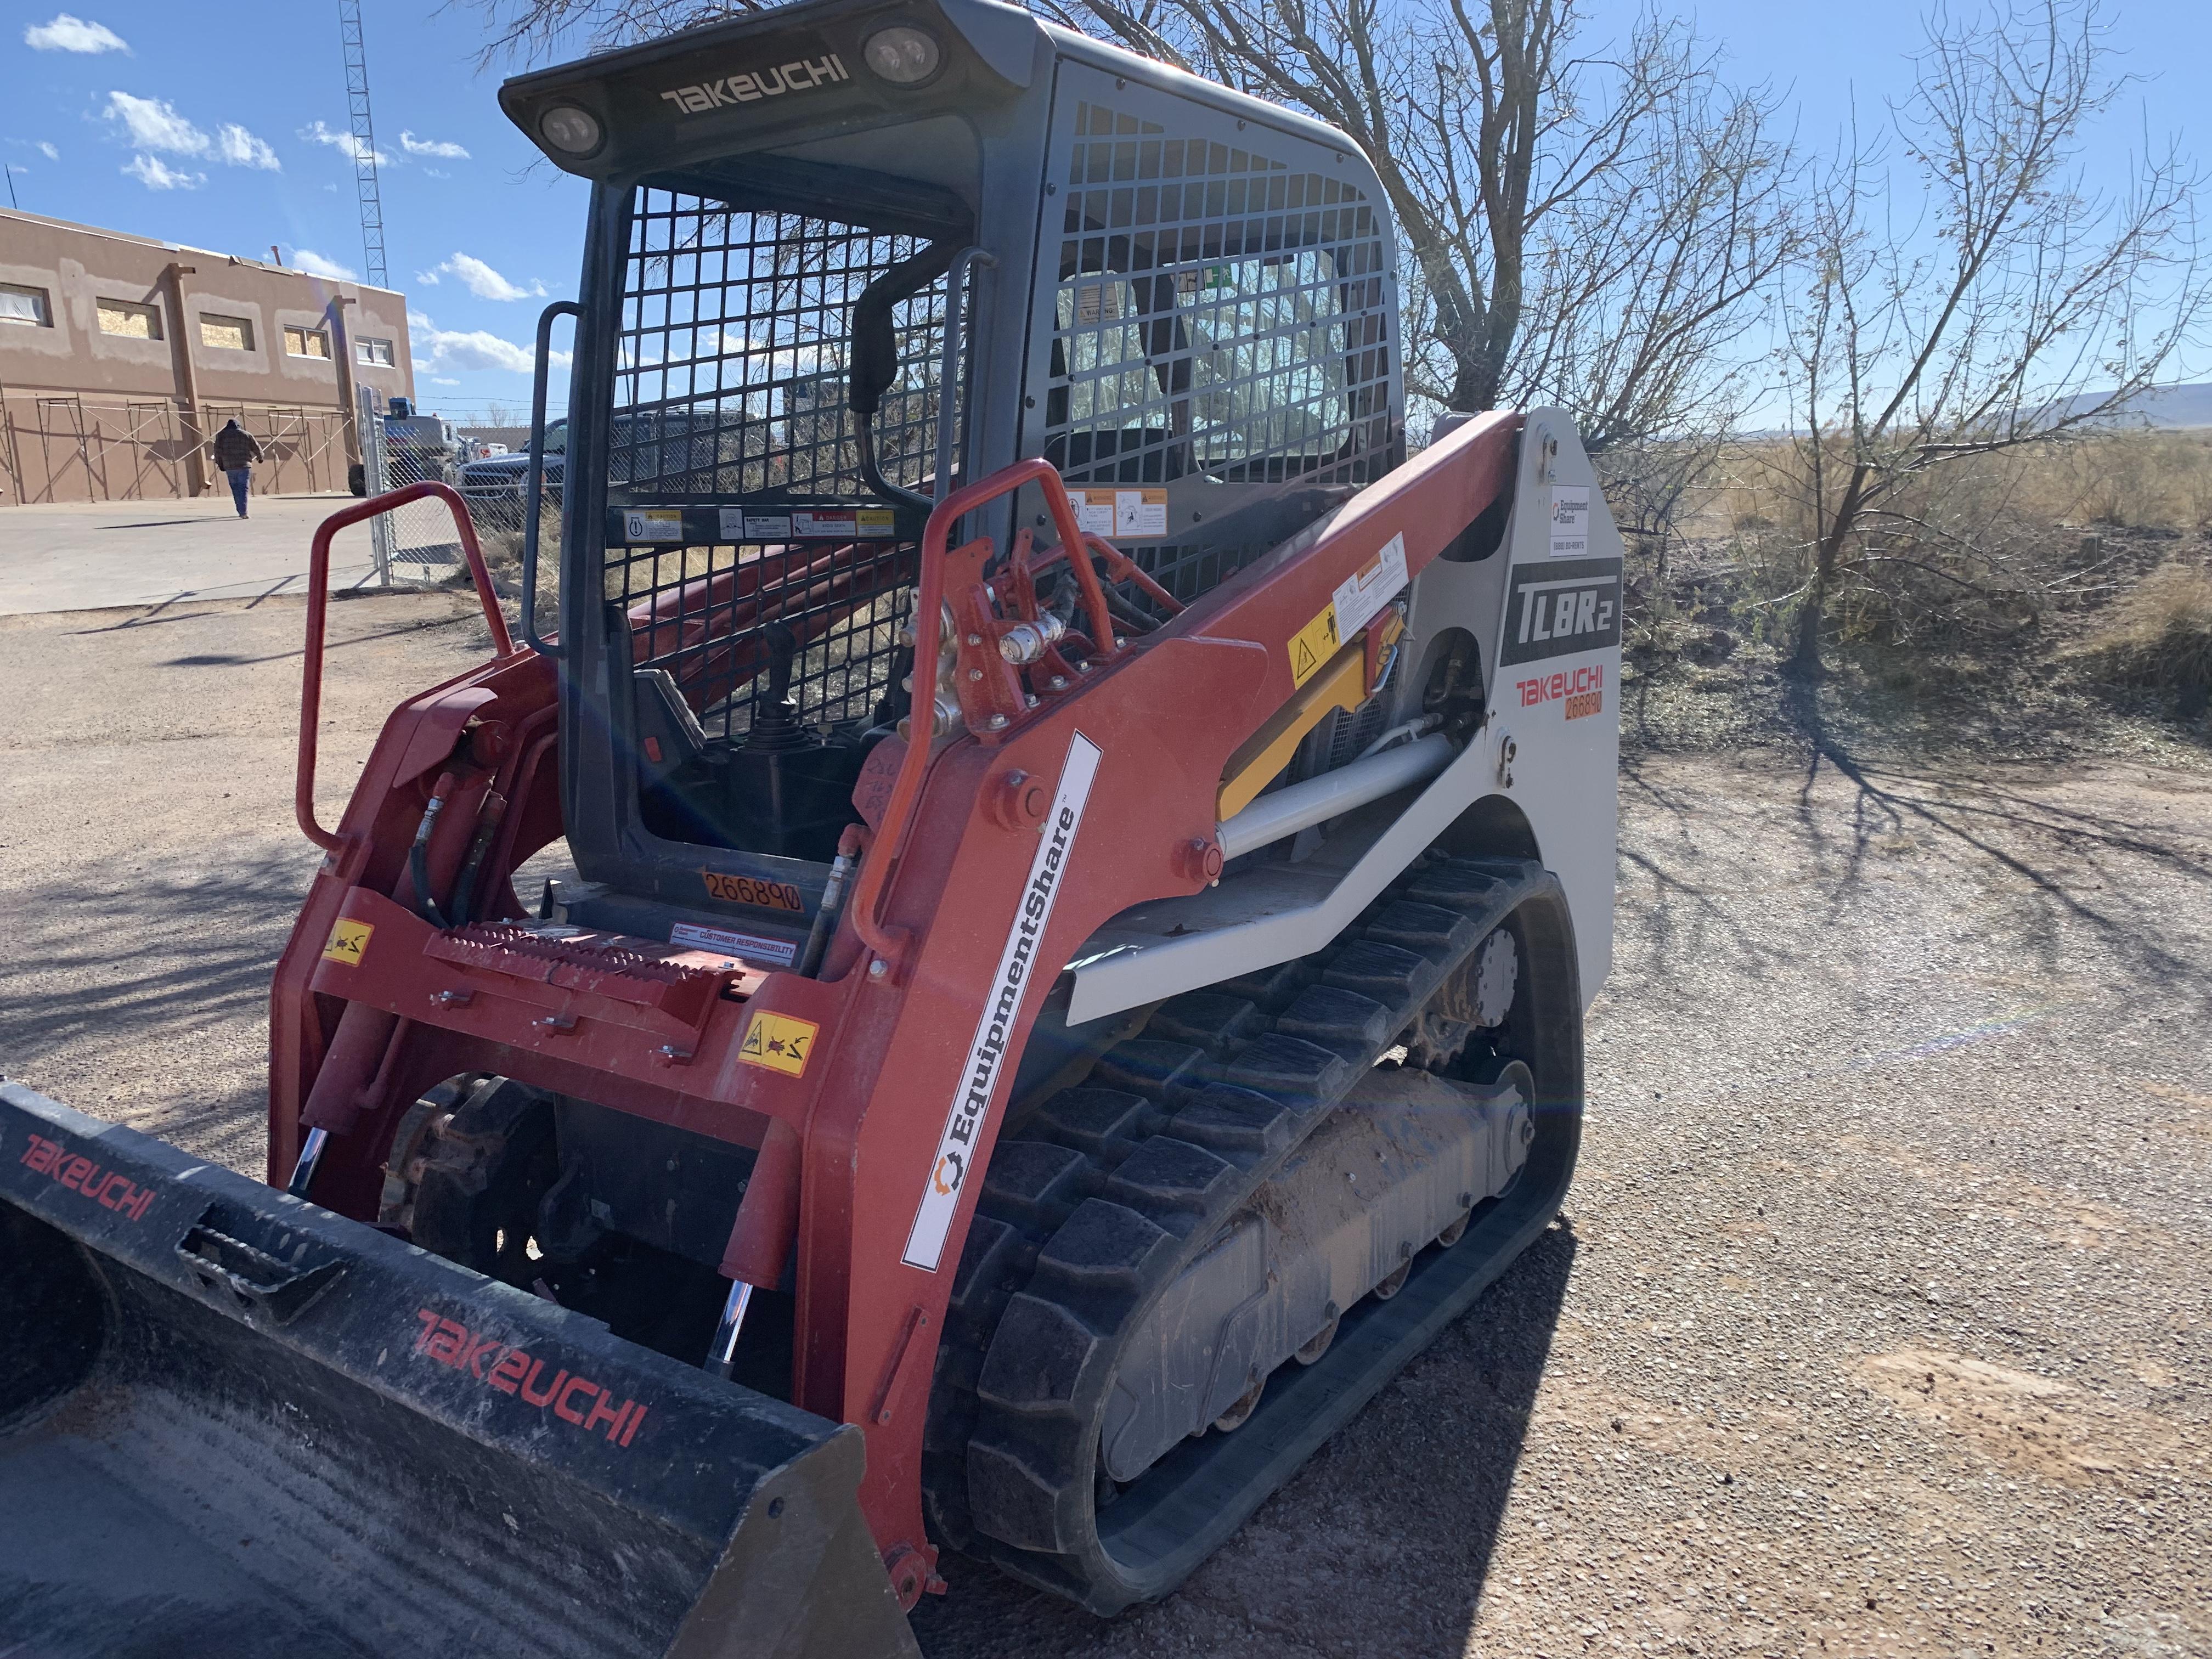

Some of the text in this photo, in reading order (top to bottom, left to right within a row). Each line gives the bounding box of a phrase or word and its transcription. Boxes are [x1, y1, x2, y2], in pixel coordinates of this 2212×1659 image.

[661, 54, 849, 114] TAKEUCHI
[1560, 500, 1588, 513] Equipment
[1560, 513, 1575, 523] Share
[1516, 664, 1603, 707] TAKEUCHI
[1565, 691, 1602, 720] 266890
[706, 873, 801, 910] 266890
[699, 932, 736, 944] CUSTOMER
[737, 938, 795, 955] RESPONSIBILITY
[950, 806, 1074, 1146] EquipmentShare
[20, 1133, 157, 1221] TAKEUCHI
[414, 1308, 648, 1447] TAKEUCHI
